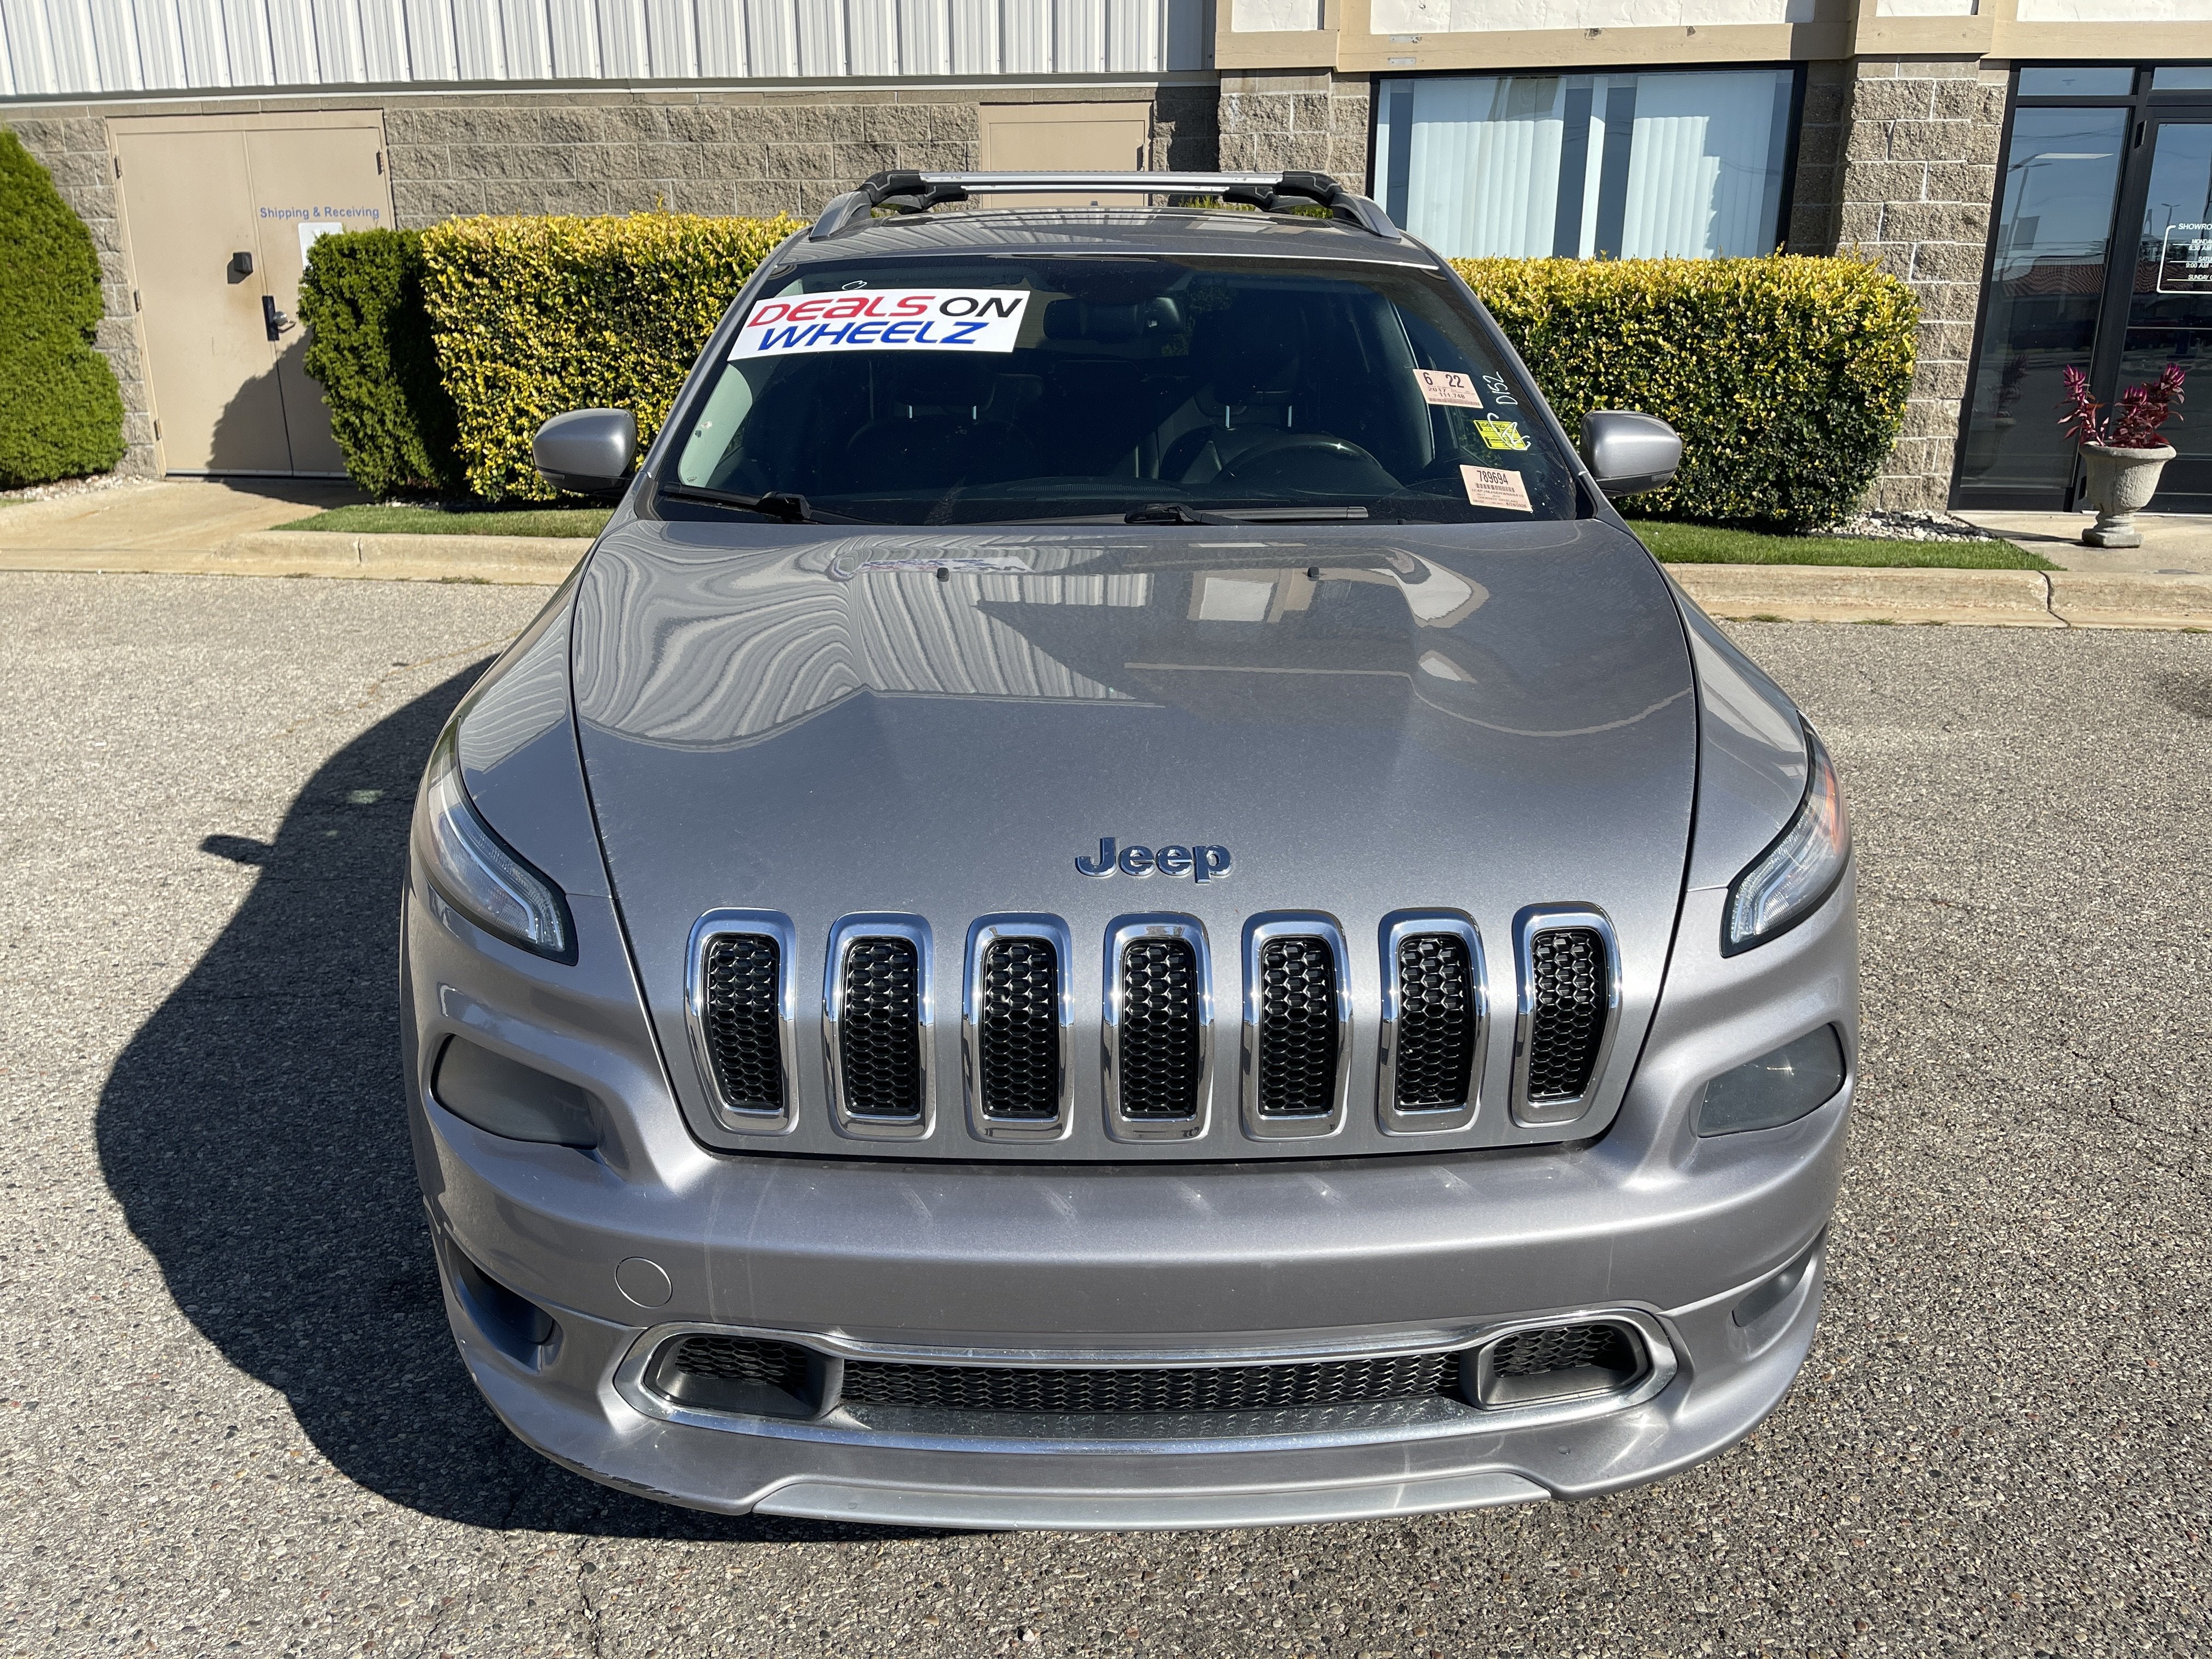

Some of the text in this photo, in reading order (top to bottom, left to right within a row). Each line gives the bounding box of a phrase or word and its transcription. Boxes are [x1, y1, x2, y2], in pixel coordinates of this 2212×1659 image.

[260, 206, 380, 219] Shipping & Receiving
[939, 297, 1024, 318] ON
[757, 320, 990, 351] WHEELZ
[1423, 372, 1465, 388] 6 22
[1476, 470, 1509, 485] 789694
[1075, 837, 1233, 883] Jeep
